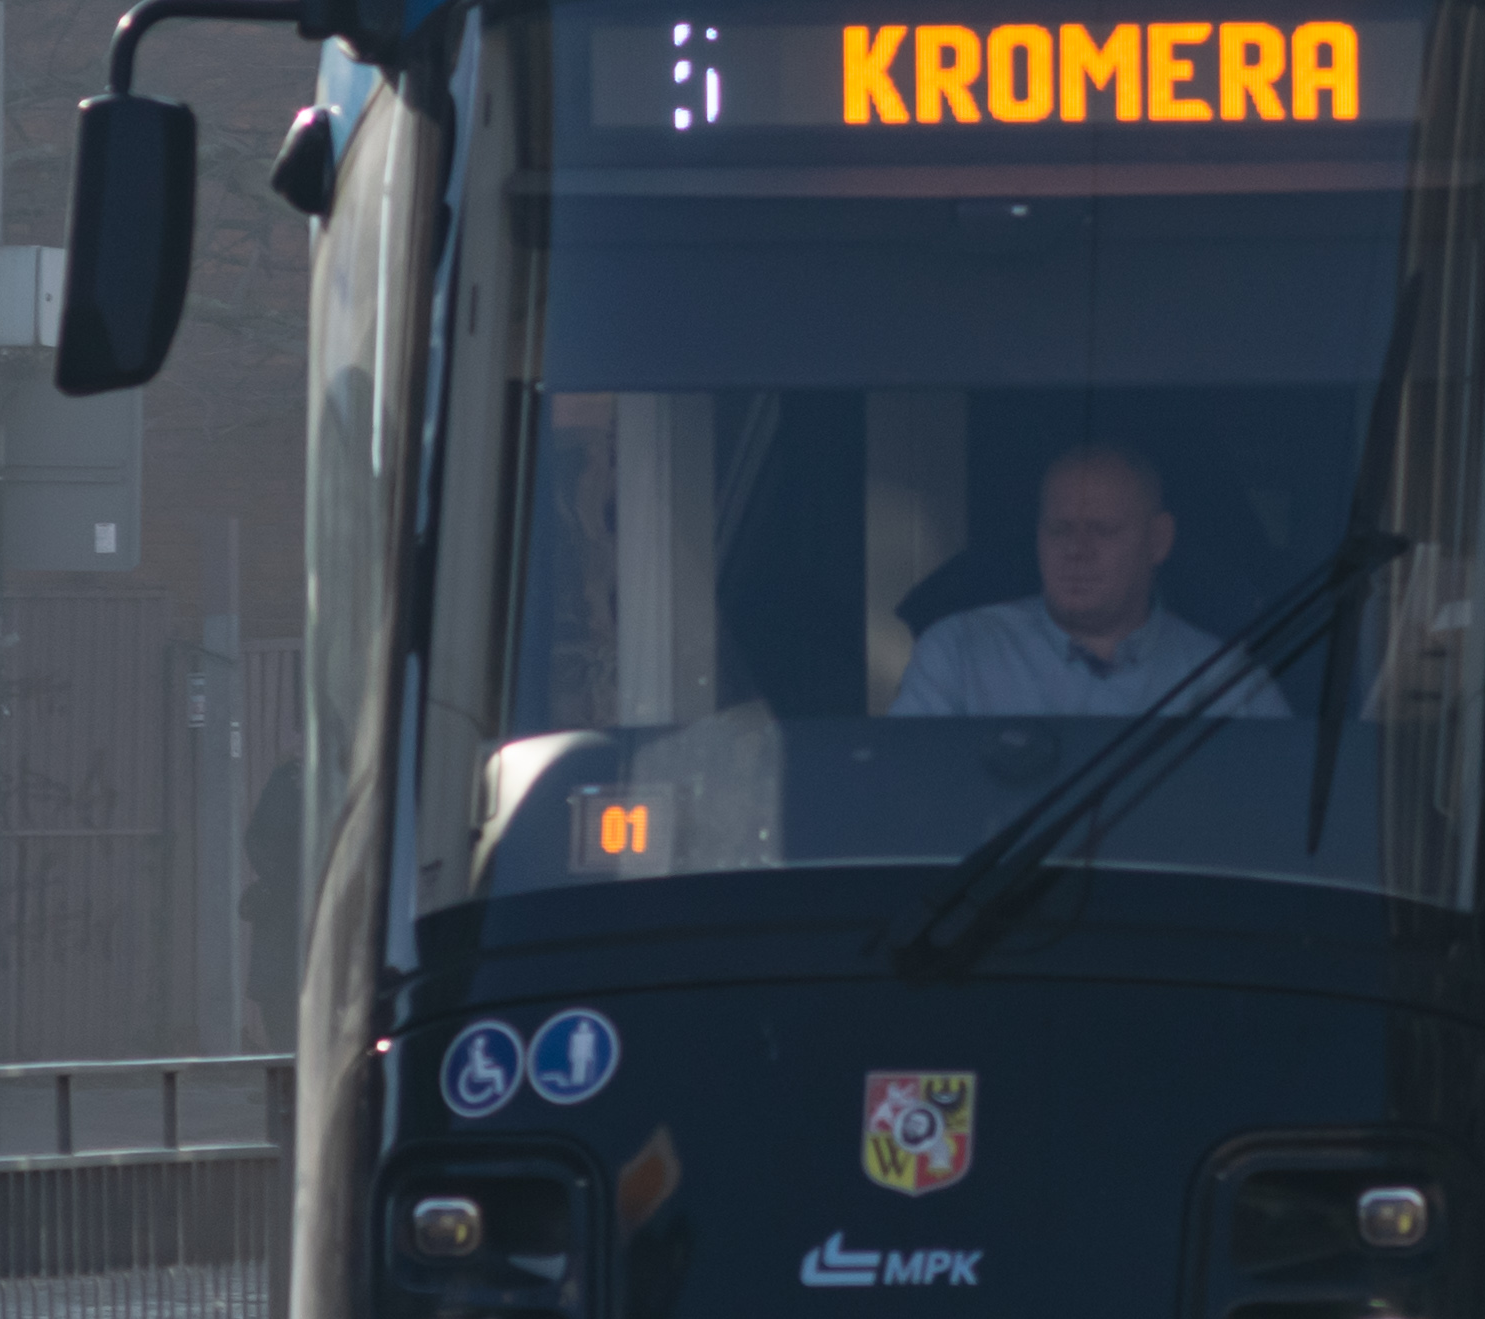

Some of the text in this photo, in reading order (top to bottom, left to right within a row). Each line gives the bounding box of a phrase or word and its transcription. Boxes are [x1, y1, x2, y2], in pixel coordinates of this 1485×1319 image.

[842, 20, 1359, 126] KROMERA
[601, 804, 649, 854] 01
[882, 1249, 985, 1286] MPK
